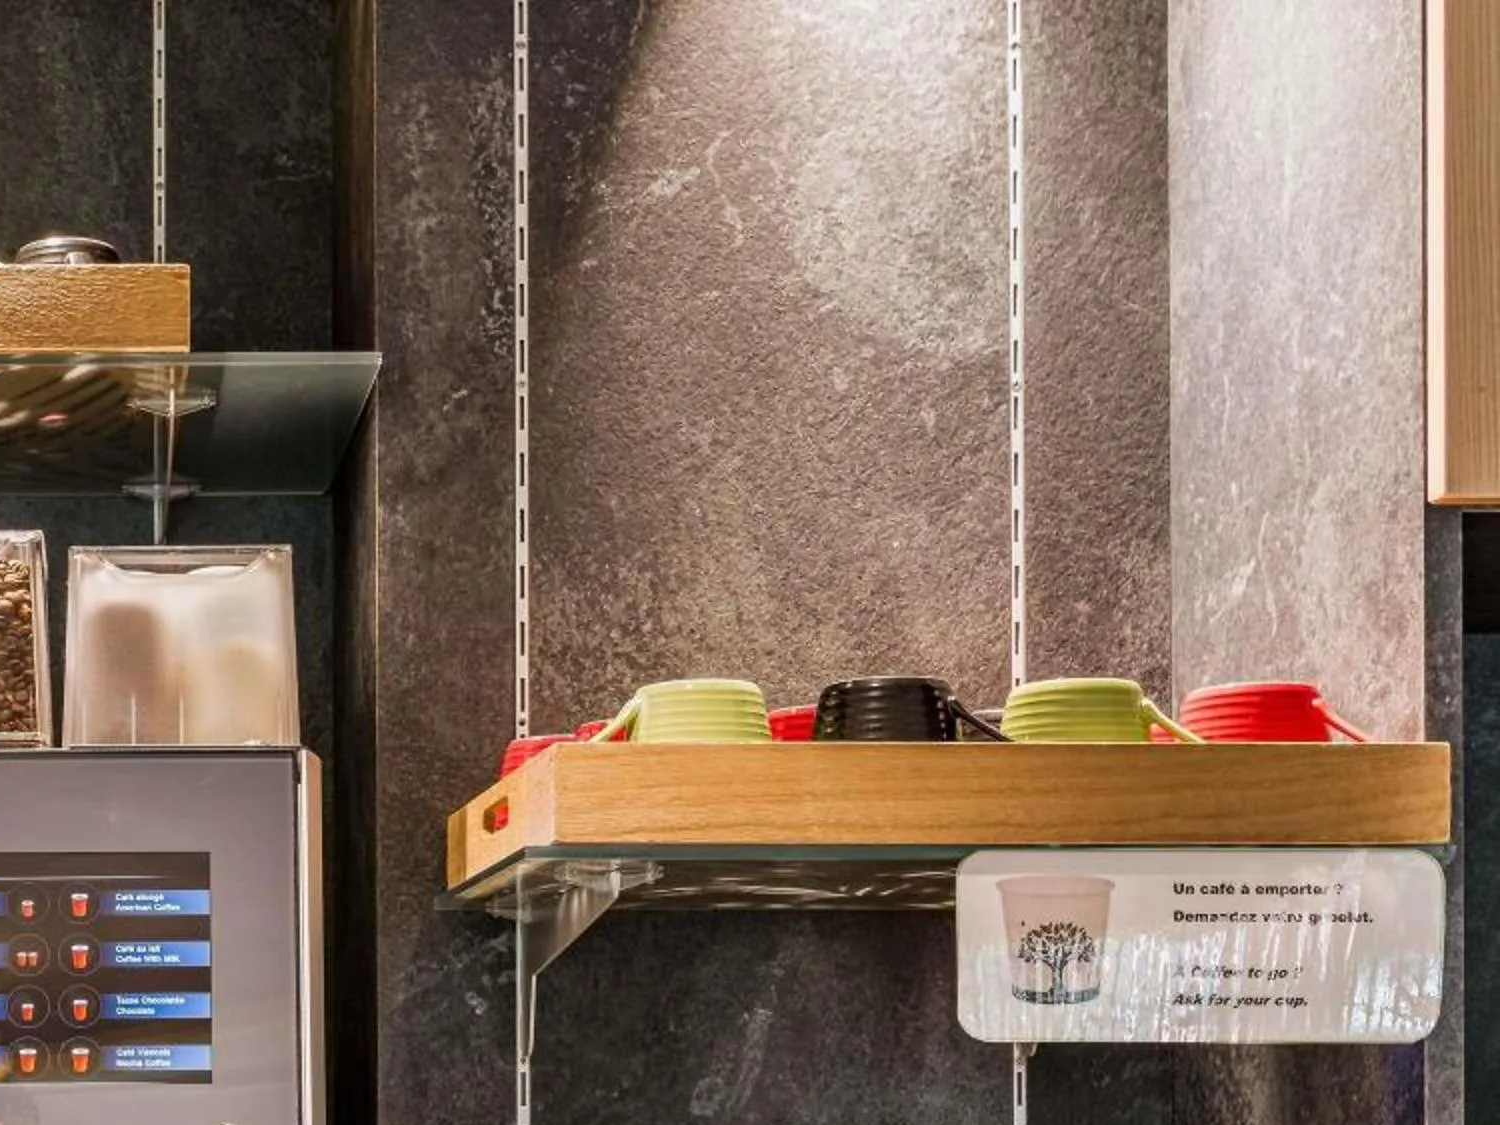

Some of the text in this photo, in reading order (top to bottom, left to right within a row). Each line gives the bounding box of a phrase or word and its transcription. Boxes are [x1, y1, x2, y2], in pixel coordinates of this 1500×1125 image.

[1173, 883, 1195, 895] Un
[1200, 883, 1235, 895] café
[1240, 883, 1250, 895] à
[1309, 911, 1373, 925] gelet.
[1247, 967, 1262, 979] to
[1172, 993, 1308, 1009] Ask for your cup.
